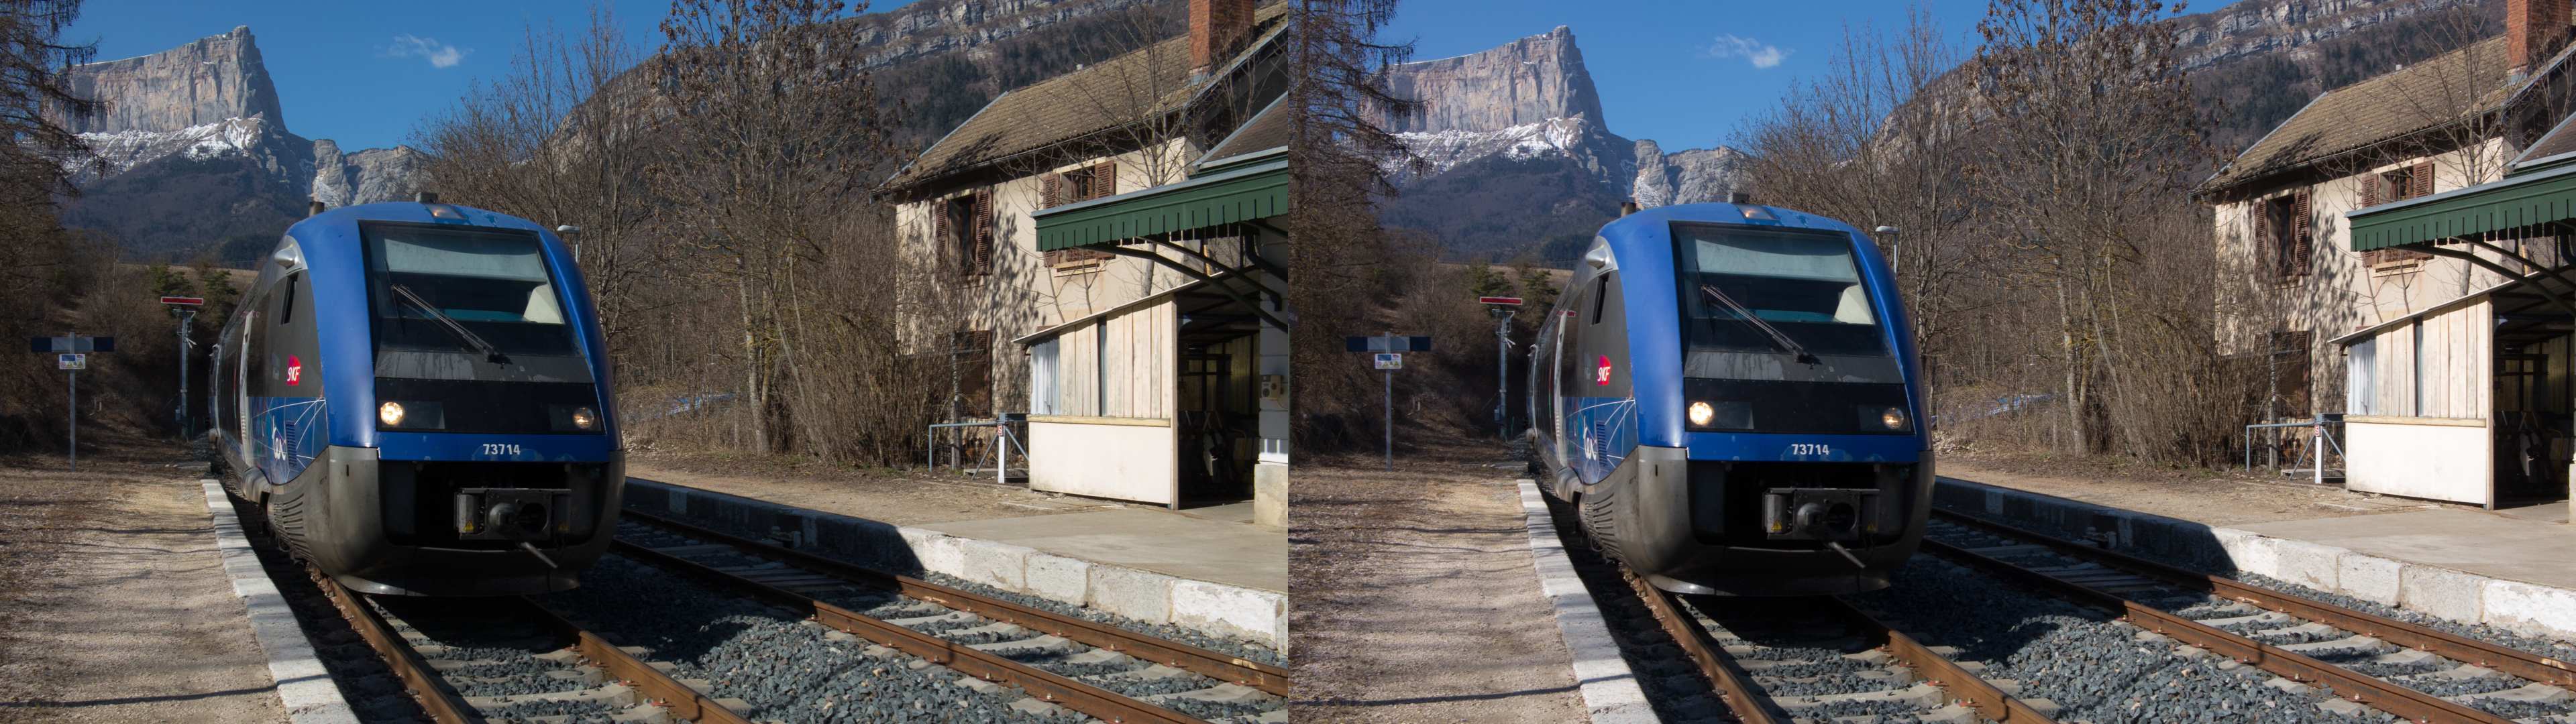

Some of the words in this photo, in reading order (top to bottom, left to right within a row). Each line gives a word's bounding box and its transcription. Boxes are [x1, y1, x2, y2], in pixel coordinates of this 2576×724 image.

[287, 366, 301, 381] SNCF
[1597, 367, 1611, 381] SNCF
[483, 444, 521, 455] 73714
[1792, 444, 1829, 455] 73714
